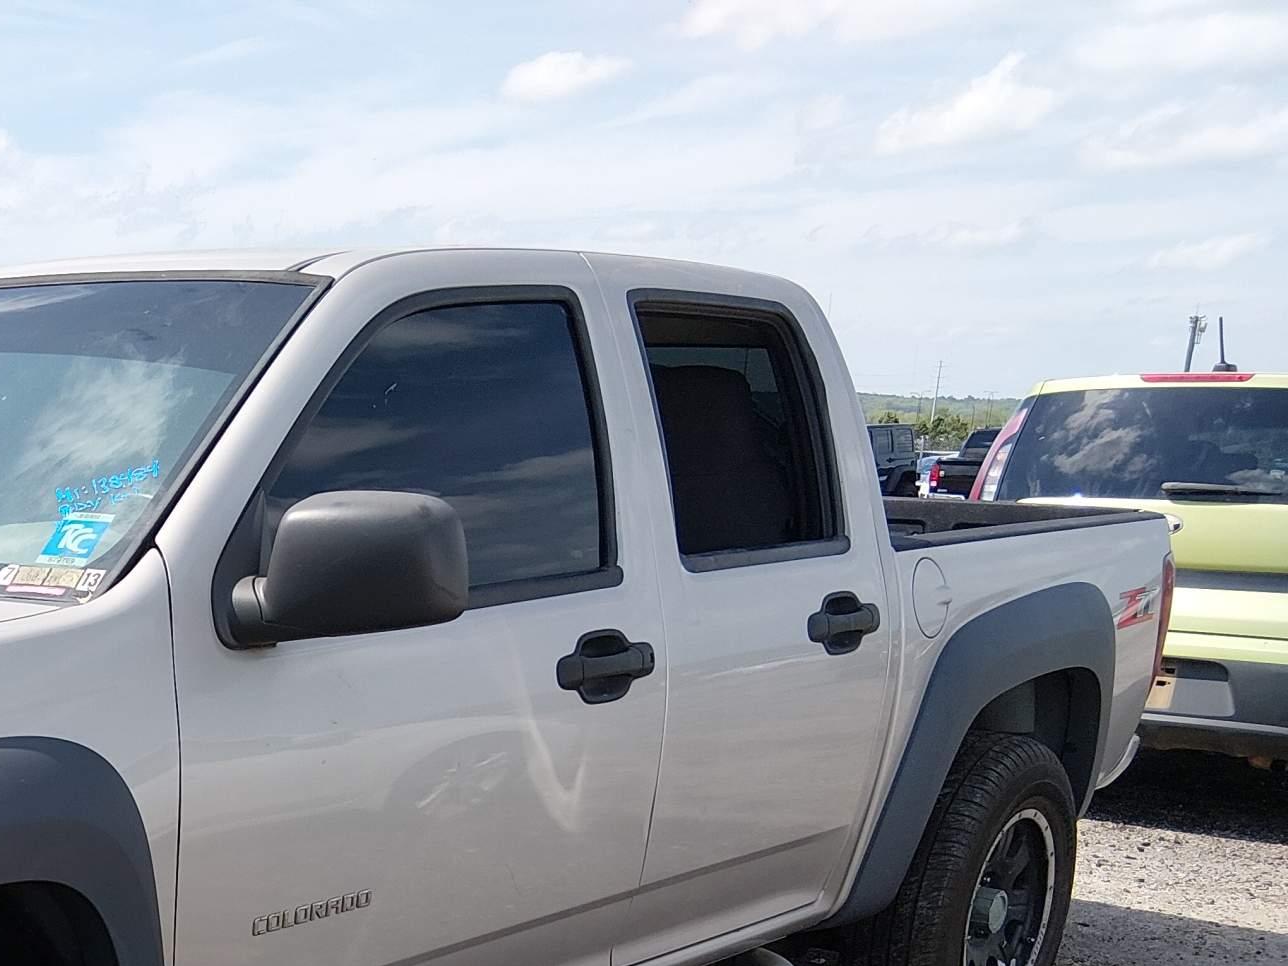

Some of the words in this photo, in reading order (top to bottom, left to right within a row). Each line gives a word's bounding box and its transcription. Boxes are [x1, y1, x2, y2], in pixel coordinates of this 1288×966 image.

[2, 566, 14, 581] 7
[81, 572, 101, 588] 13
[252, 888, 373, 937] COLORADO
